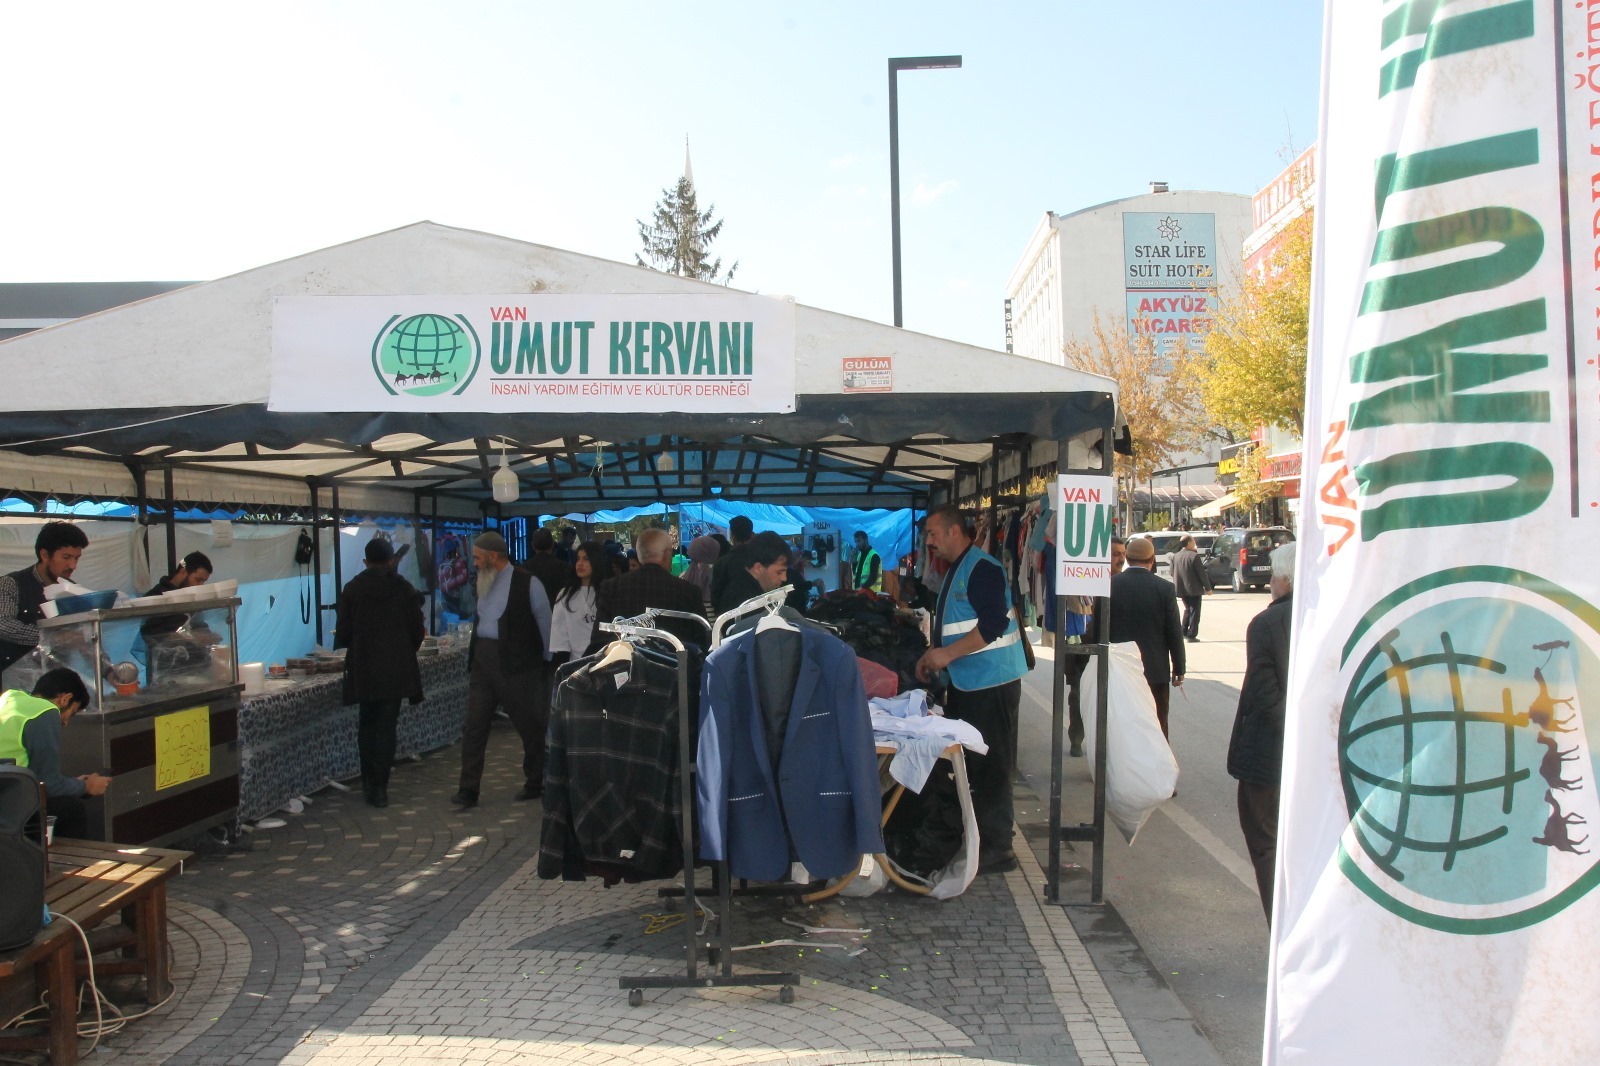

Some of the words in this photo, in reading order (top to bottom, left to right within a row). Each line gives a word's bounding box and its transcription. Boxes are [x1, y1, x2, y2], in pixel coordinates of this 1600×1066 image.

[1135, 245, 1171, 258] STAR
[1175, 240, 1207, 258] LİFE
[1129, 259, 1161, 278] SUİT
[1139, 295, 1207, 313] AKYÜZ
[490, 306, 527, 321] VAN
[1347, 127, 1555, 543] UMUT
[490, 321, 596, 375] UMUT
[609, 321, 754, 375] KERVANI
[845, 358, 889, 369] GÜLÜM
[491, 382, 531, 396] İNSANİ
[533, 384, 579, 396] YARDIM
[582, 383, 623, 396] EĞİTİM
[626, 384, 642, 396] VE
[645, 383, 692, 396] KÜLTÜR
[695, 382, 750, 396] DERNEĞİ
[1063, 487, 1100, 503] VAN
[1320, 419, 1358, 557] VAN
[1063, 564, 1103, 579] İNSANİ
